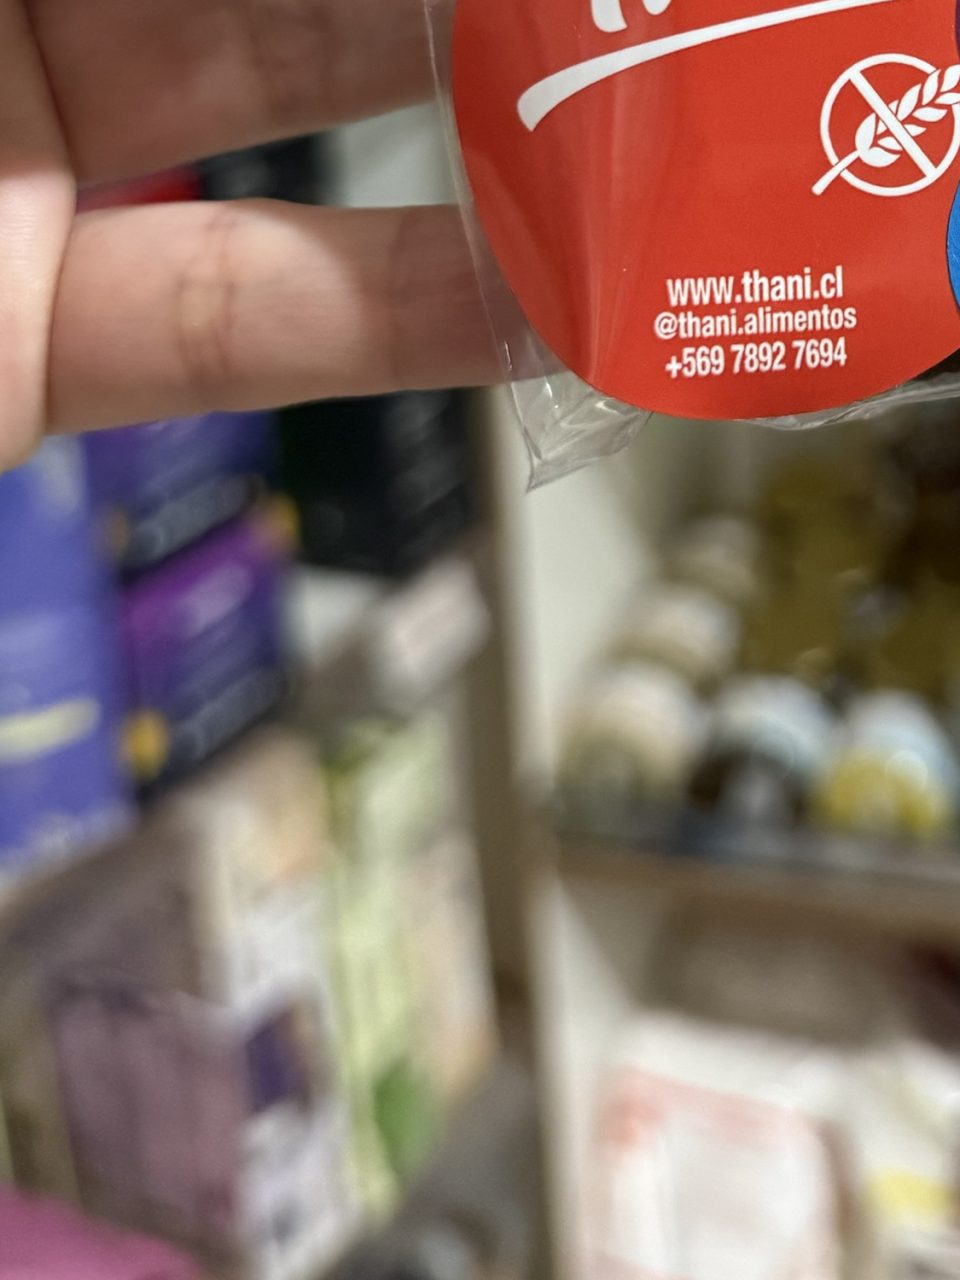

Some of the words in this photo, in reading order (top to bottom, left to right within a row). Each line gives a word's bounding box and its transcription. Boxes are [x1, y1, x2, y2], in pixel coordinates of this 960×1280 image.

[666, 265, 844, 307] www.thani.cl
[654, 303, 857, 340] @thani.alimentos
[665, 345, 725, 379] +569
[730, 340, 786, 374] 7892
[792, 336, 847, 370] 7694
